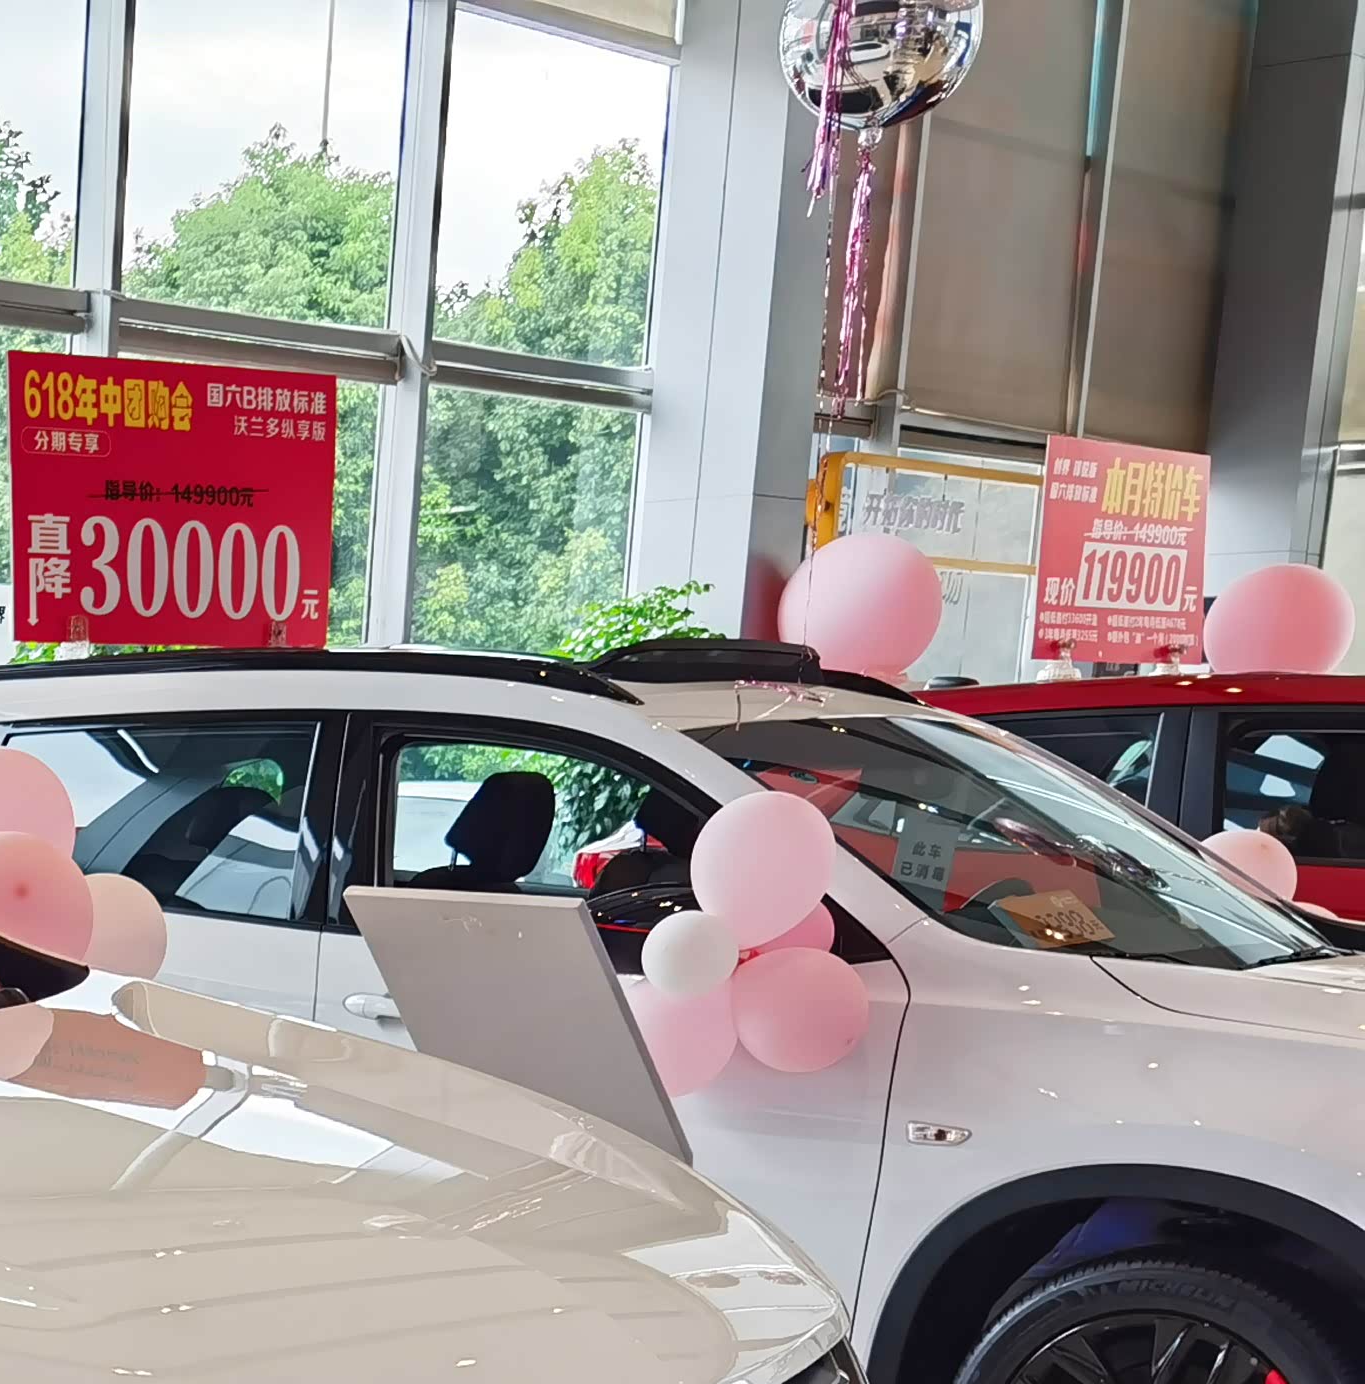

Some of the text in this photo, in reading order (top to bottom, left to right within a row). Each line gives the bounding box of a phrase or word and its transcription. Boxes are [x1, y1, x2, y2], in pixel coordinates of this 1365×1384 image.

[24, 369, 194, 432] 618年中团购会
[206, 383, 327, 416] 国六B排放标准
[34, 430, 100, 454] 分期专享
[233, 416, 326, 441] 沃兰多纵享版
[1101, 456, 1202, 522] 本月特价车
[27, 513, 71, 600] 直降
[80, 515, 301, 622] 30000
[1043, 576, 1076, 607] 现价
[1082, 549, 1181, 606] 119900
[301, 589, 320, 620] 元
[1182, 585, 1198, 612] 元
[912, 841, 942, 859] 此车
[900, 861, 945, 882] 已消毒
